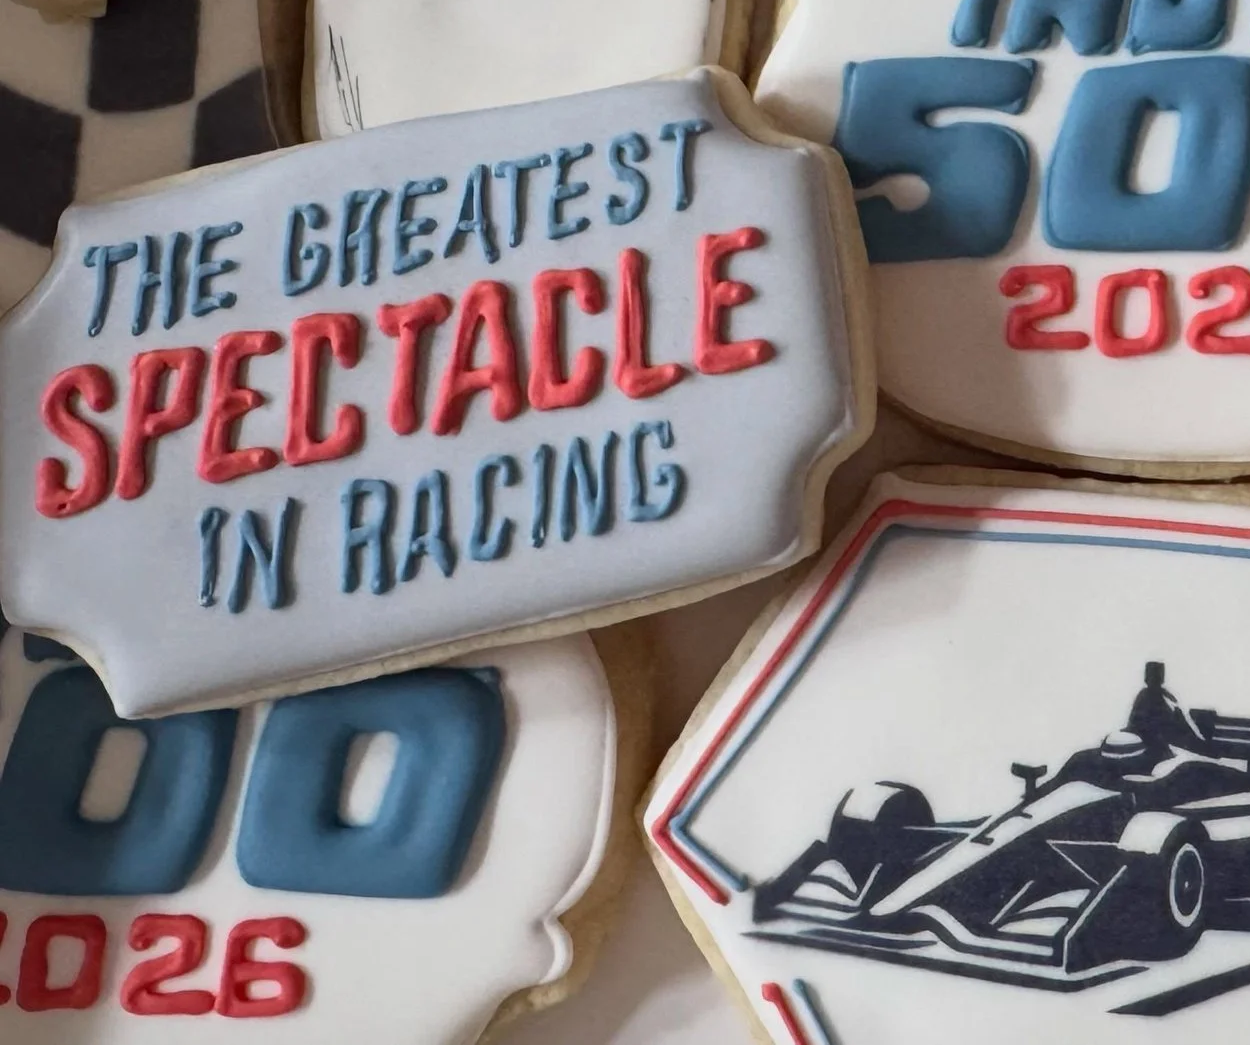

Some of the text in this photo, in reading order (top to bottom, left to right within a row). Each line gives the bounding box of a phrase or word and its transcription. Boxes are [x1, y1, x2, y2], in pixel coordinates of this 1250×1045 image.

[83, 118, 713, 338] THE GREATEST
[35, 225, 777, 519] SPECTACLE
[199, 419, 688, 614] IN RACING
[0, 913, 308, 1018] 026
